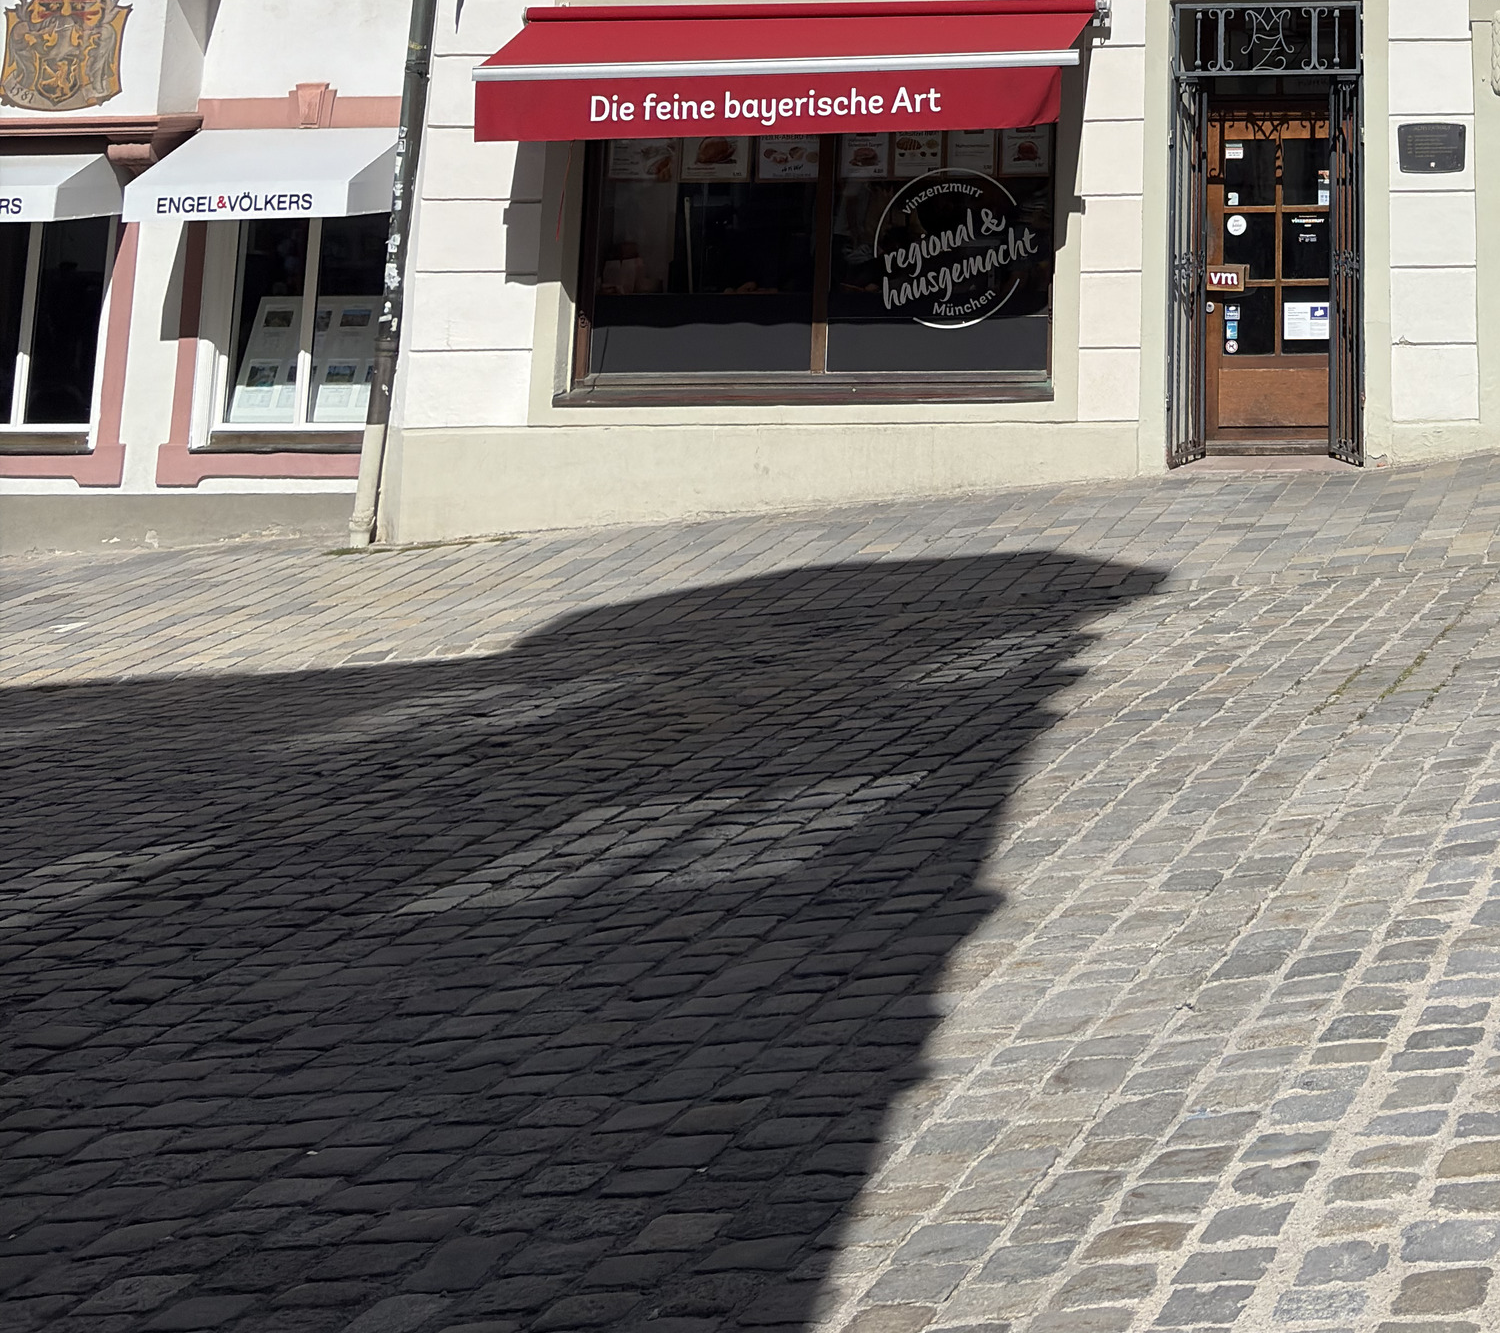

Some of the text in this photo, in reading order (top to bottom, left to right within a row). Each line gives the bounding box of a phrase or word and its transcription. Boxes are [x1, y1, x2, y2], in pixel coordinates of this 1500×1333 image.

[590, 87, 942, 126] Die feine bayerische Art
[156, 192, 313, 214] ENGEL&VÖLKERS
[902, 183, 984, 215] vinzenzmurr
[884, 208, 1006, 278] regional &
[883, 227, 1039, 310] hausgemacht
[1210, 272, 1239, 286] vm
[932, 289, 996, 317] München
